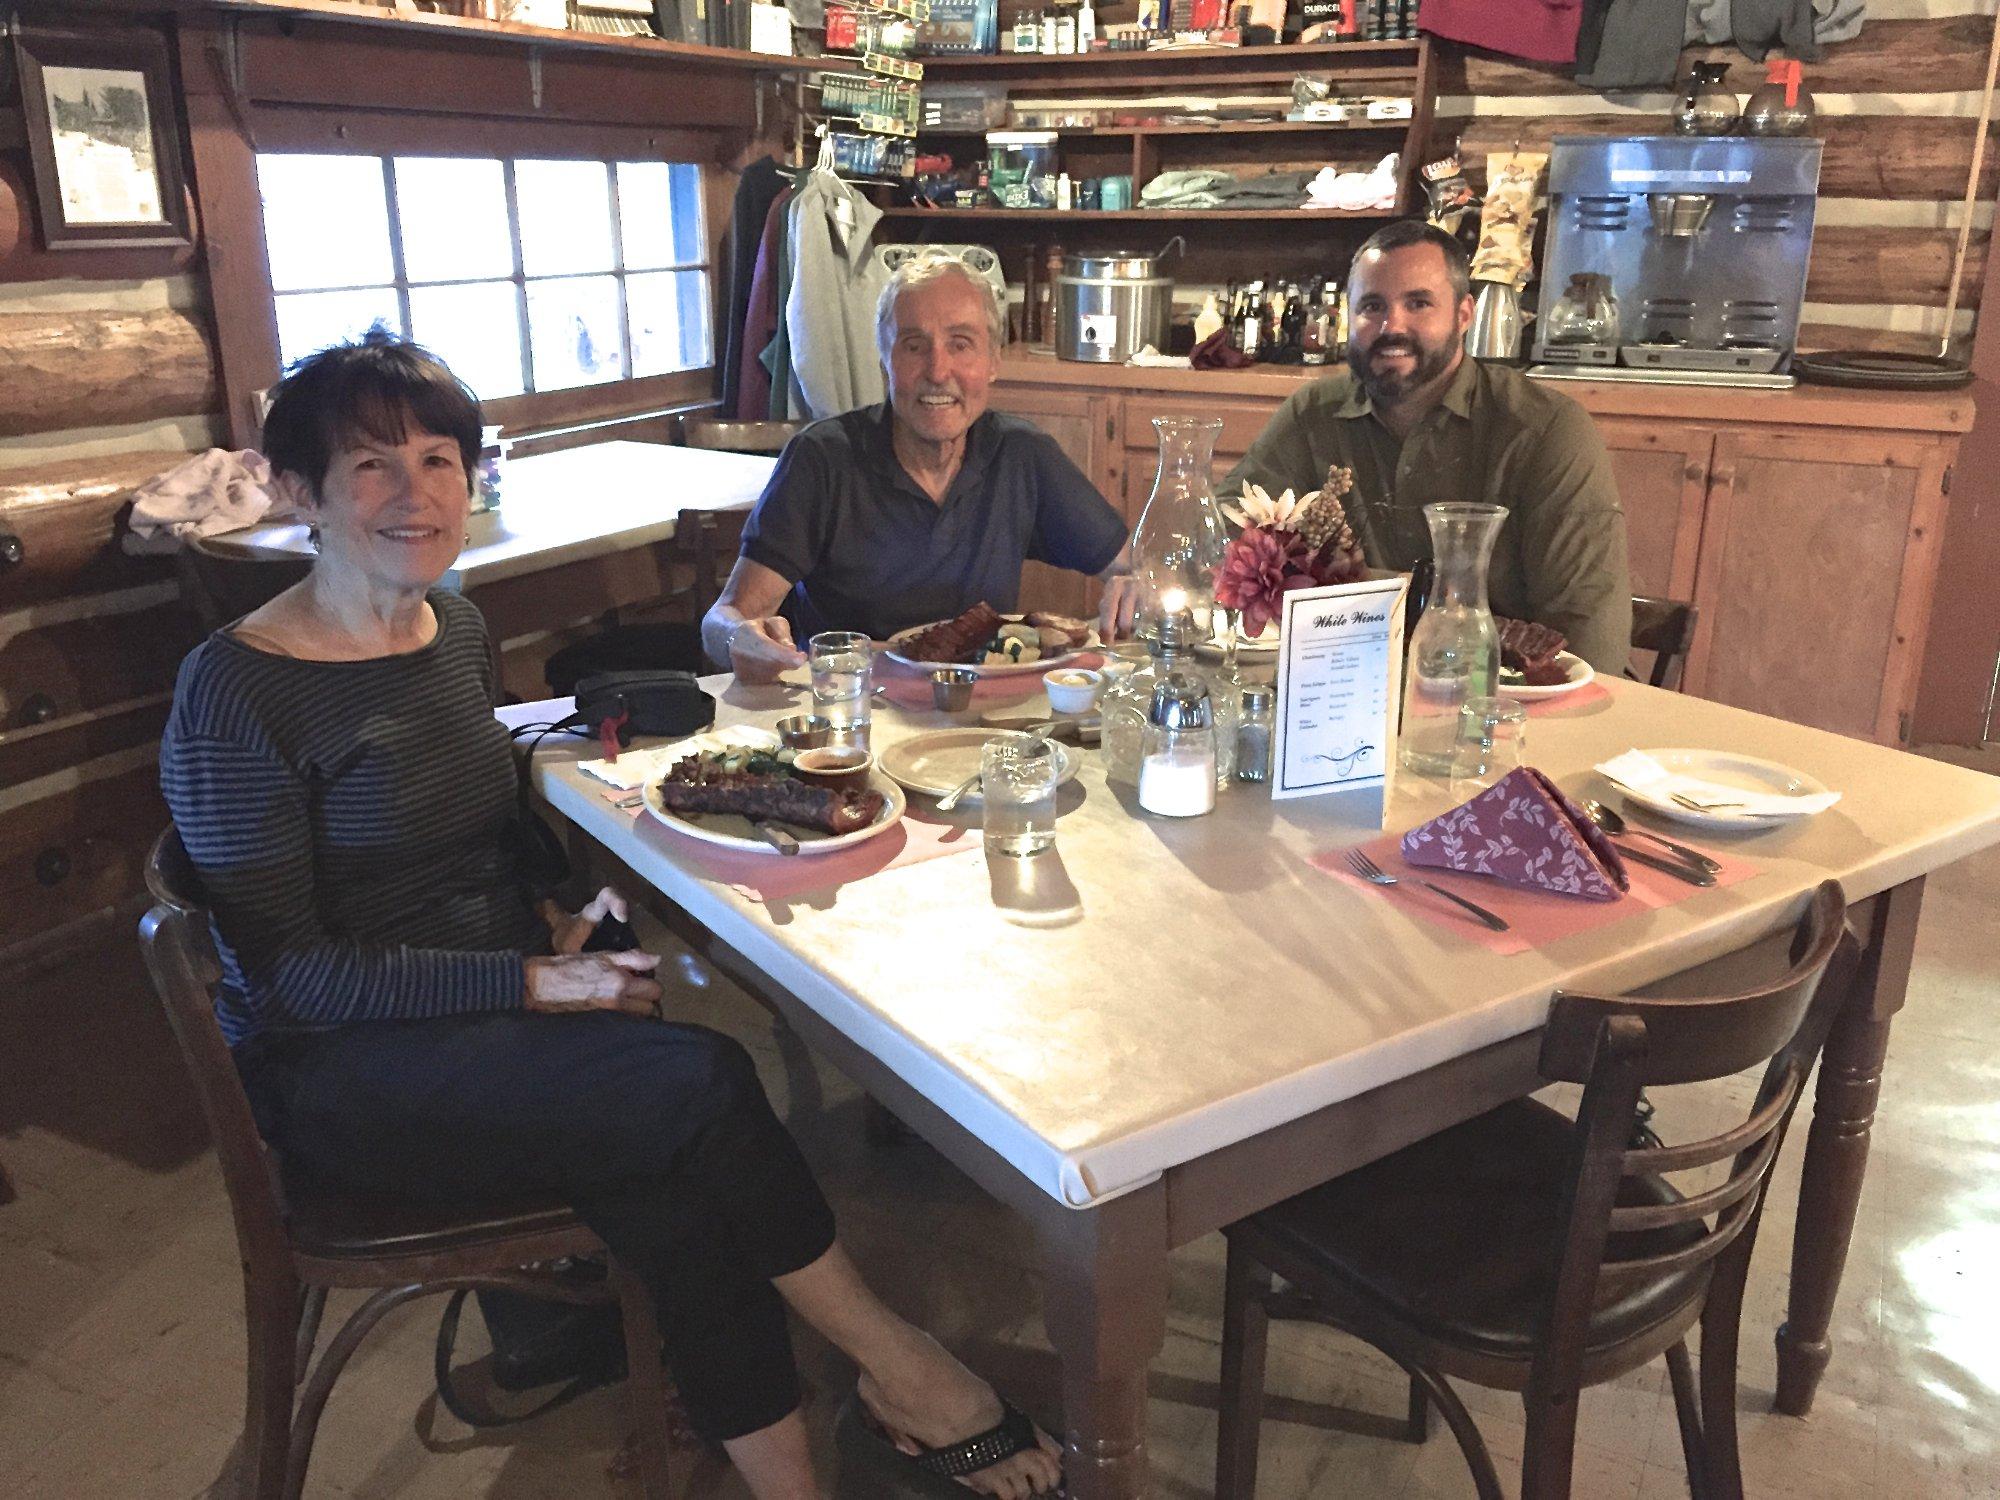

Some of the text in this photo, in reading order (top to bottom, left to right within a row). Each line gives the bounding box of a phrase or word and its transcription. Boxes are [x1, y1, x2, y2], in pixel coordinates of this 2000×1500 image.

[1304, 4, 1341, 13] DURACEL
[1313, 611, 1386, 628] White Wines
